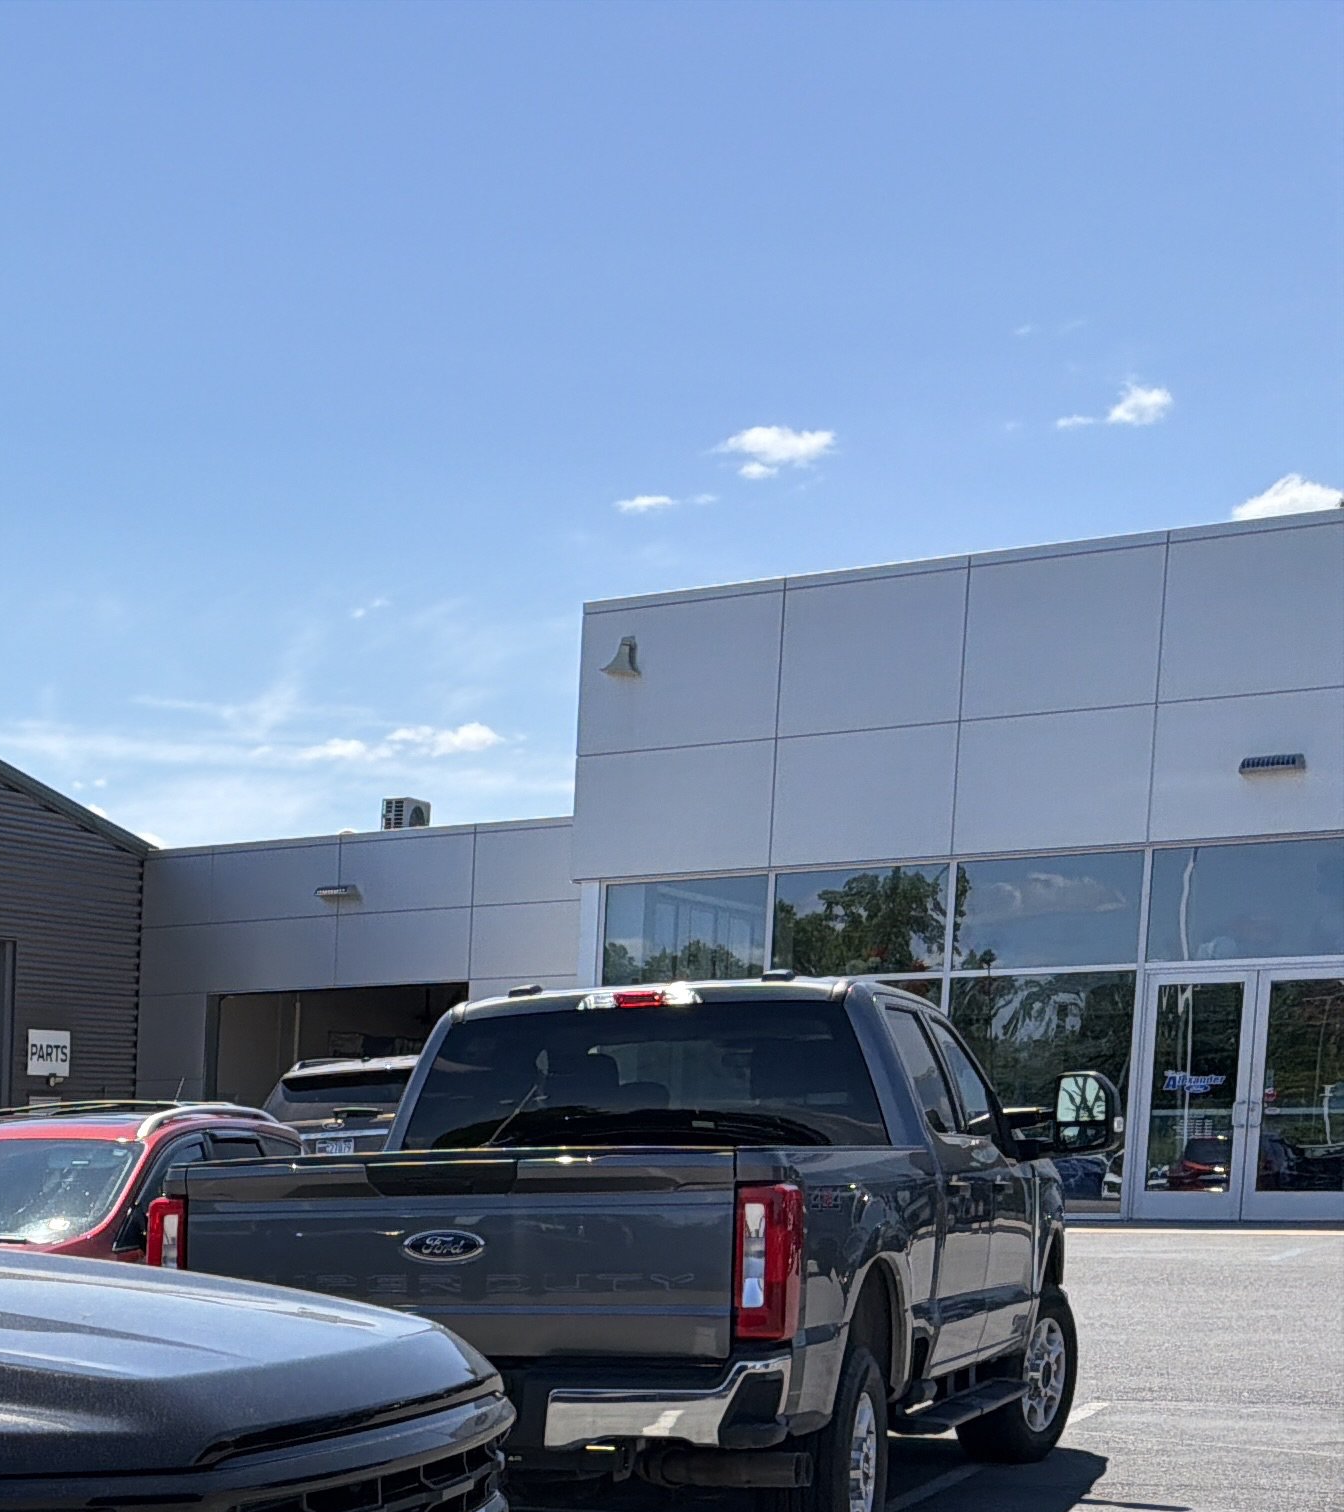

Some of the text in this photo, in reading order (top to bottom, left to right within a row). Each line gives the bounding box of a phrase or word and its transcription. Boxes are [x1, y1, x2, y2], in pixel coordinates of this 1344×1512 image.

[30, 1044, 68, 1063] PARTS
[421, 1235, 466, 1255] Ford
[486, 1273, 696, 1293] DUTY
